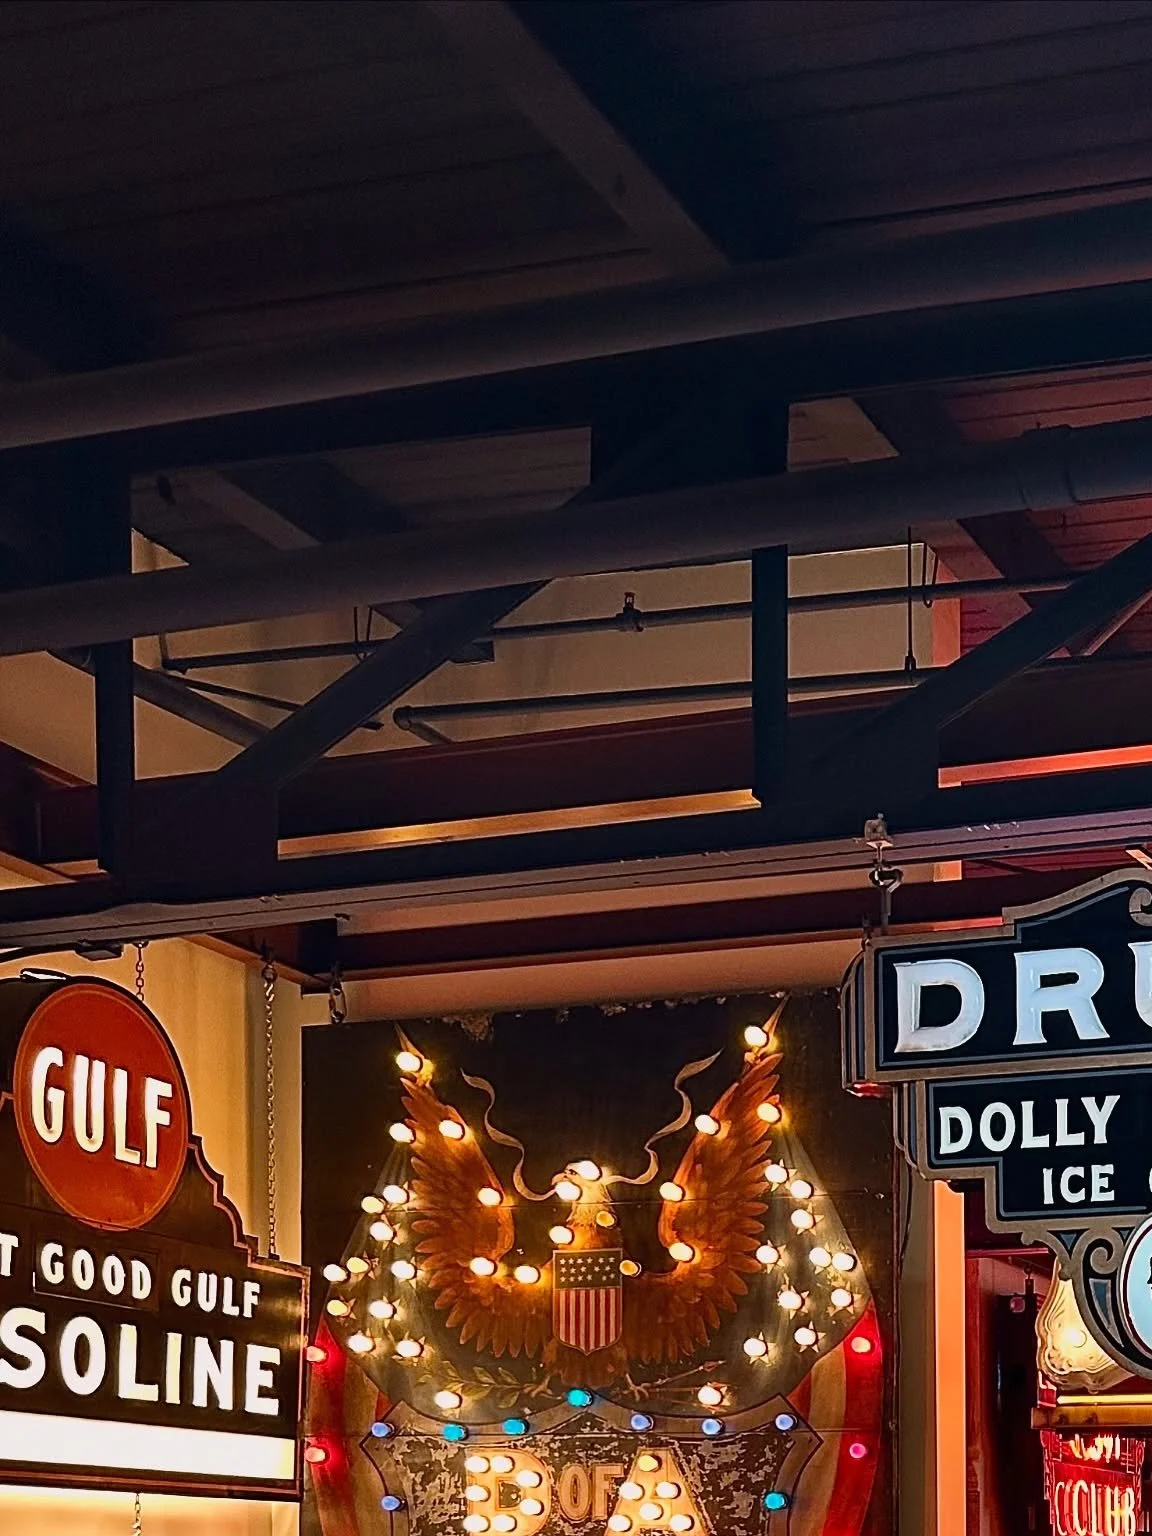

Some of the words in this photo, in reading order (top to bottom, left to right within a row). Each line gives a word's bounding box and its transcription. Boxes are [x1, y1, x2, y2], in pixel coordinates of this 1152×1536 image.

[30, 1046, 175, 1170] GULF
[937, 1095, 1121, 1155] DOLLY
[1041, 1161, 1115, 1205] ICE
[40, 1242, 152, 1300] GOOD
[171, 1268, 261, 1318] GULF
[0, 1307, 281, 1416] SOLINE
